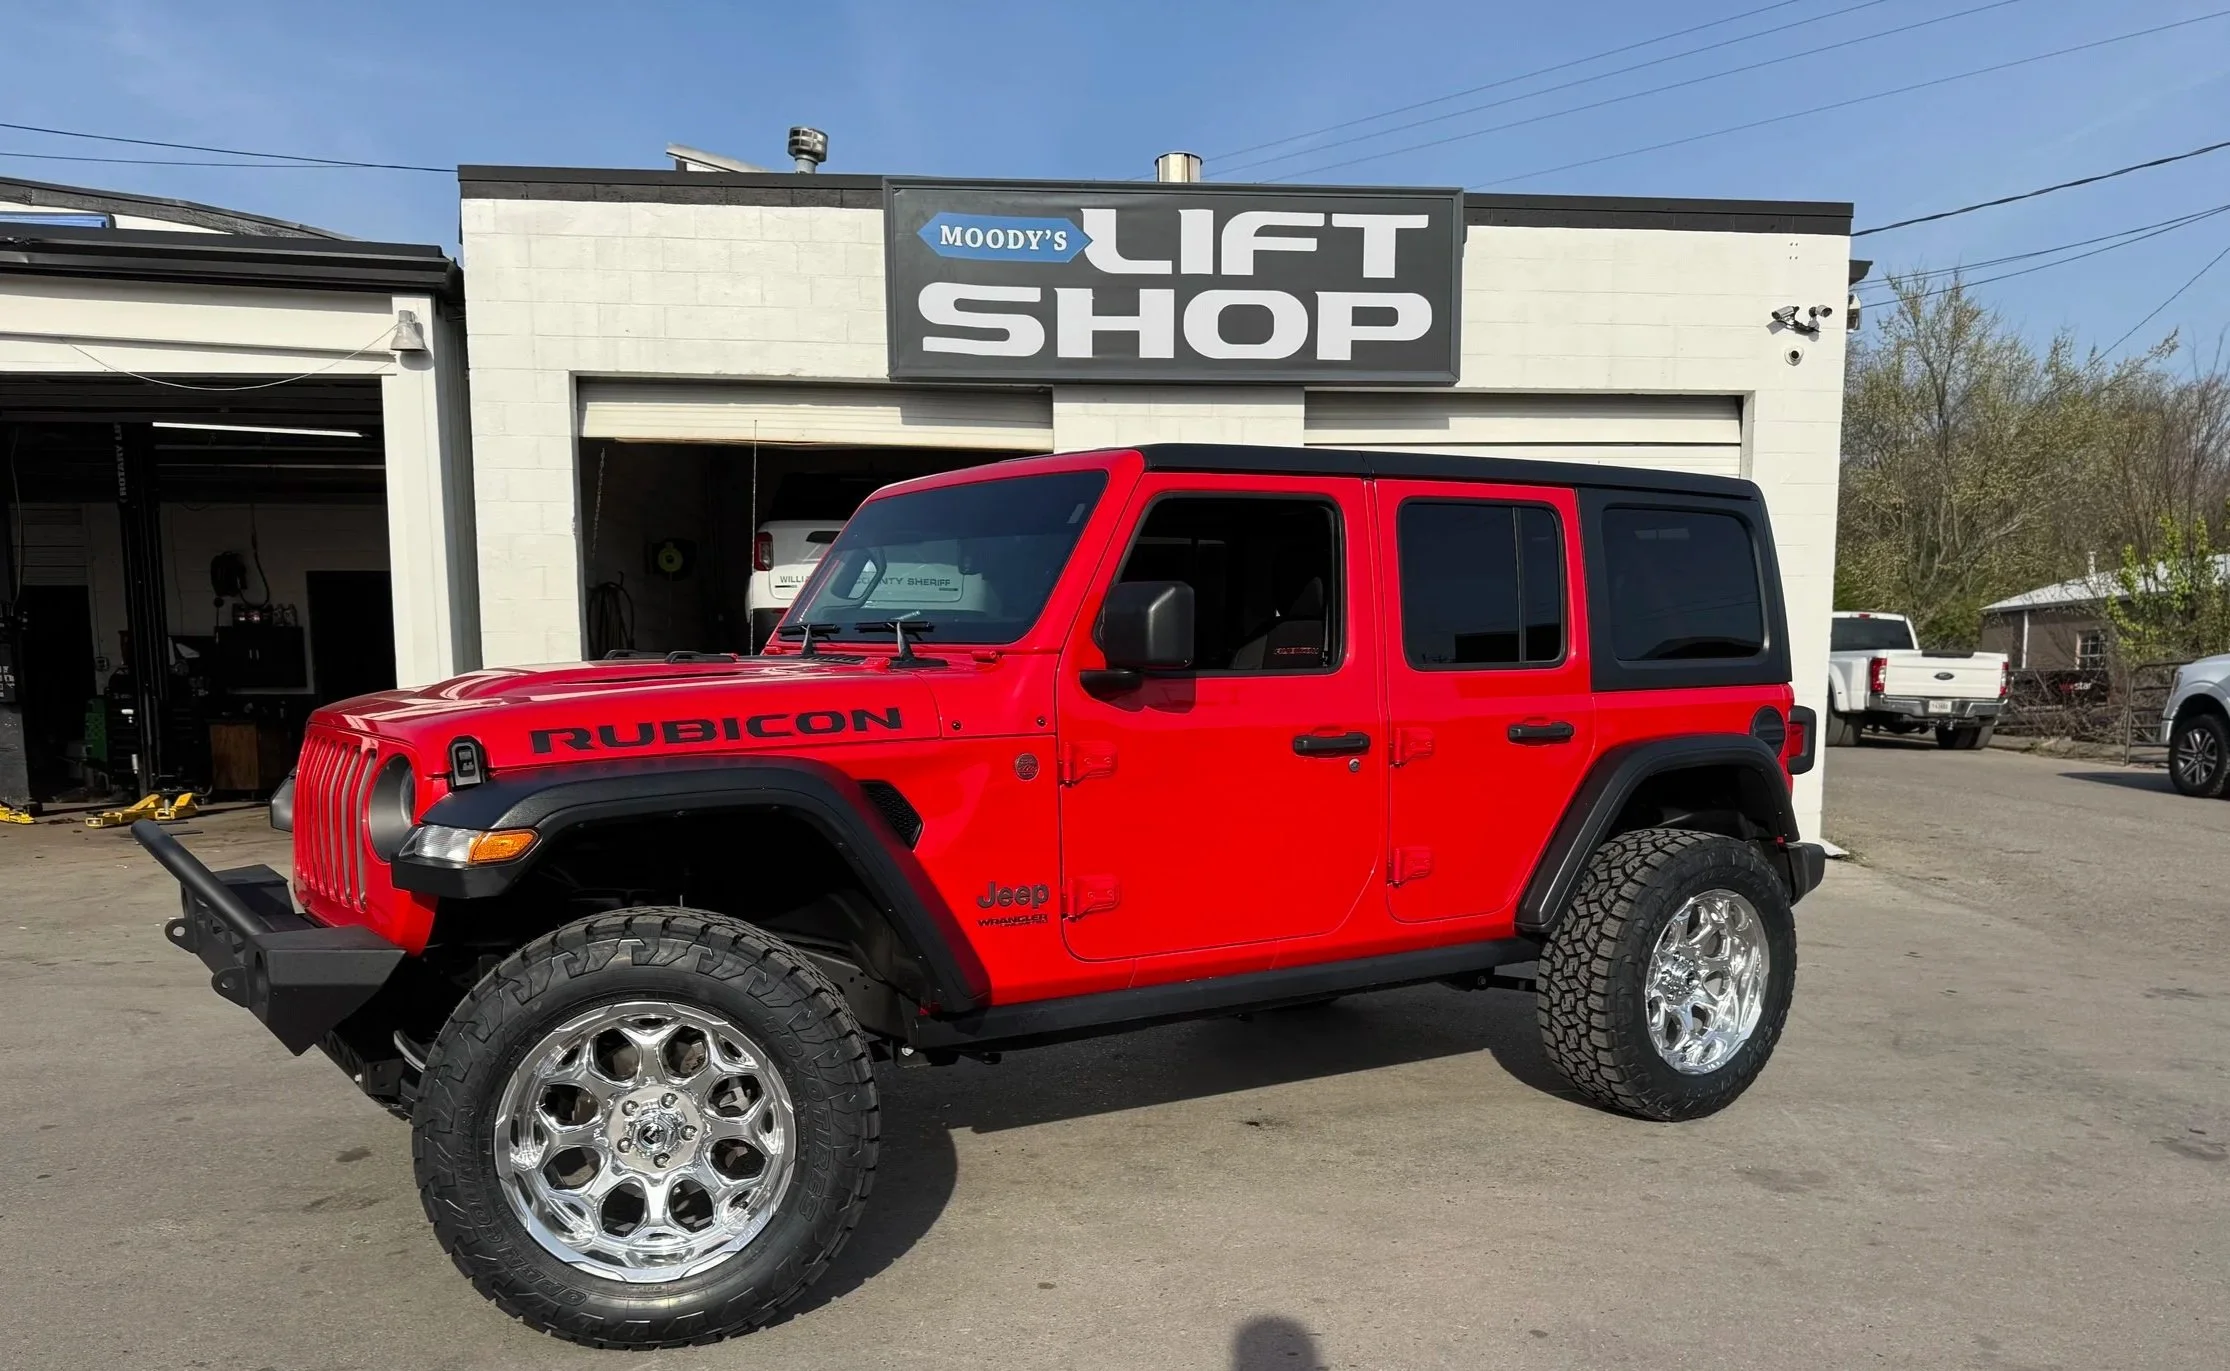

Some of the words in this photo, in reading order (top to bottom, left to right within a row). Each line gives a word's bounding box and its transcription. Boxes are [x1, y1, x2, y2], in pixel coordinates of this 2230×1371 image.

[940, 224, 1068, 251] MOODY'S
[1081, 208, 1429, 279] LIFT
[918, 281, 1433, 360] SHOP
[906, 577, 951, 587] SHERIFF
[531, 706, 902, 754] RUBICON
[977, 881, 1049, 909] Jeep
[978, 914, 1048, 926] WRANGLER
